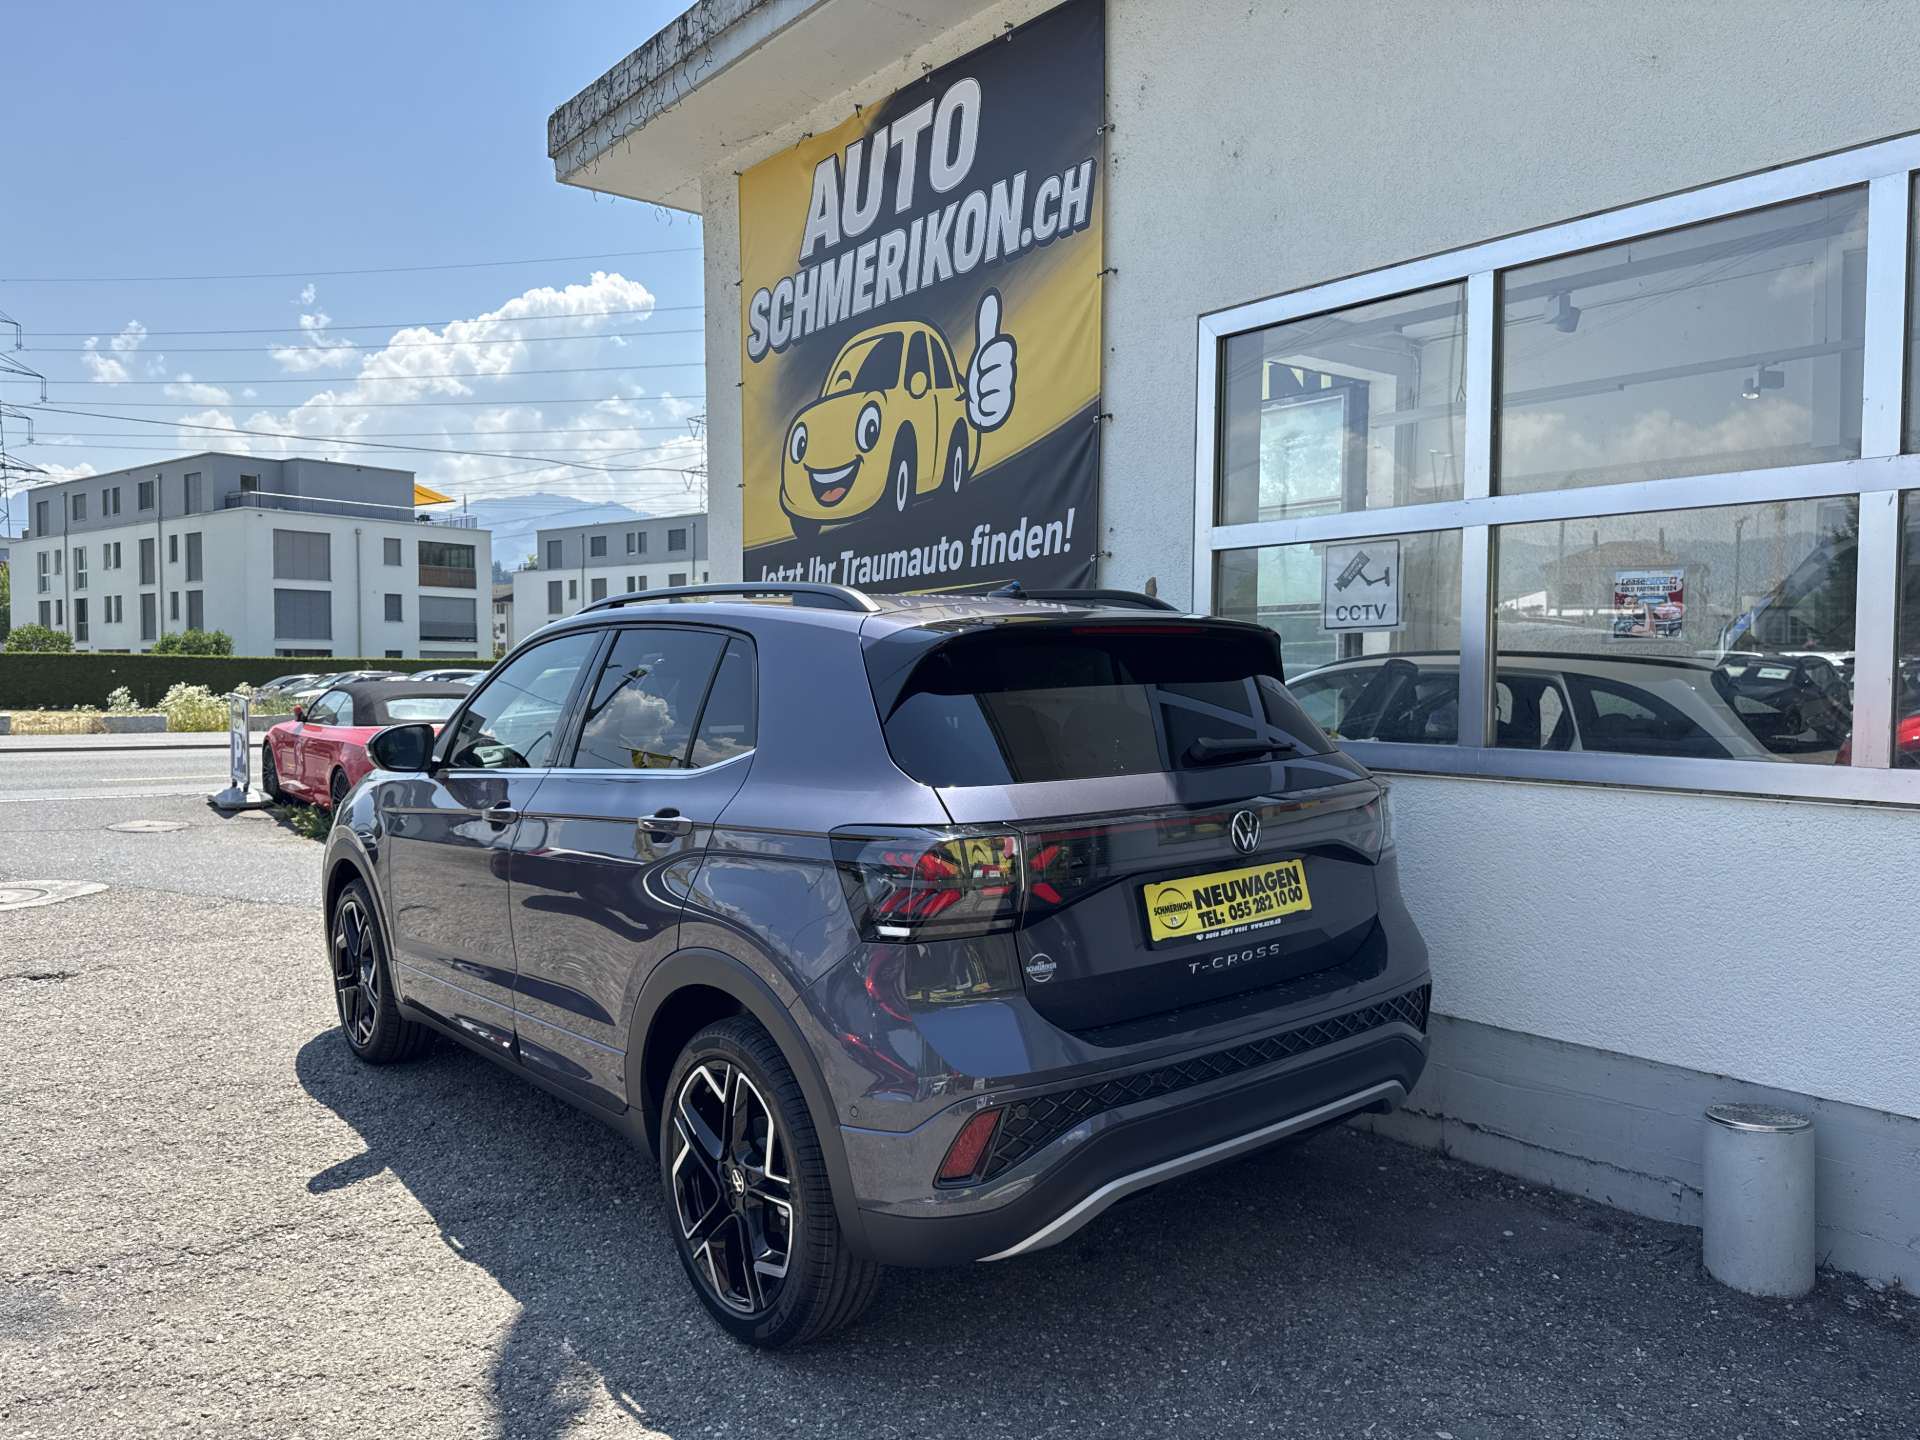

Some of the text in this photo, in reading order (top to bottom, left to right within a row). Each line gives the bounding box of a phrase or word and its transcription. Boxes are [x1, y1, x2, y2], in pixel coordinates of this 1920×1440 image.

[799, 77, 982, 263] AUTO
[746, 159, 1096, 361] SCHMERIKON.CH
[808, 556, 836, 584] Ihr
[841, 536, 964, 585] Traumauto
[970, 507, 1075, 567] finden!
[1336, 603, 1387, 621] CCTV
[1154, 900, 1193, 916] SCHMERIKON
[1192, 866, 1301, 910] NEUWAGEN
[1198, 886, 1303, 928] TEL: 055 282 10 00
[1189, 943, 1280, 974] T-CROSS
